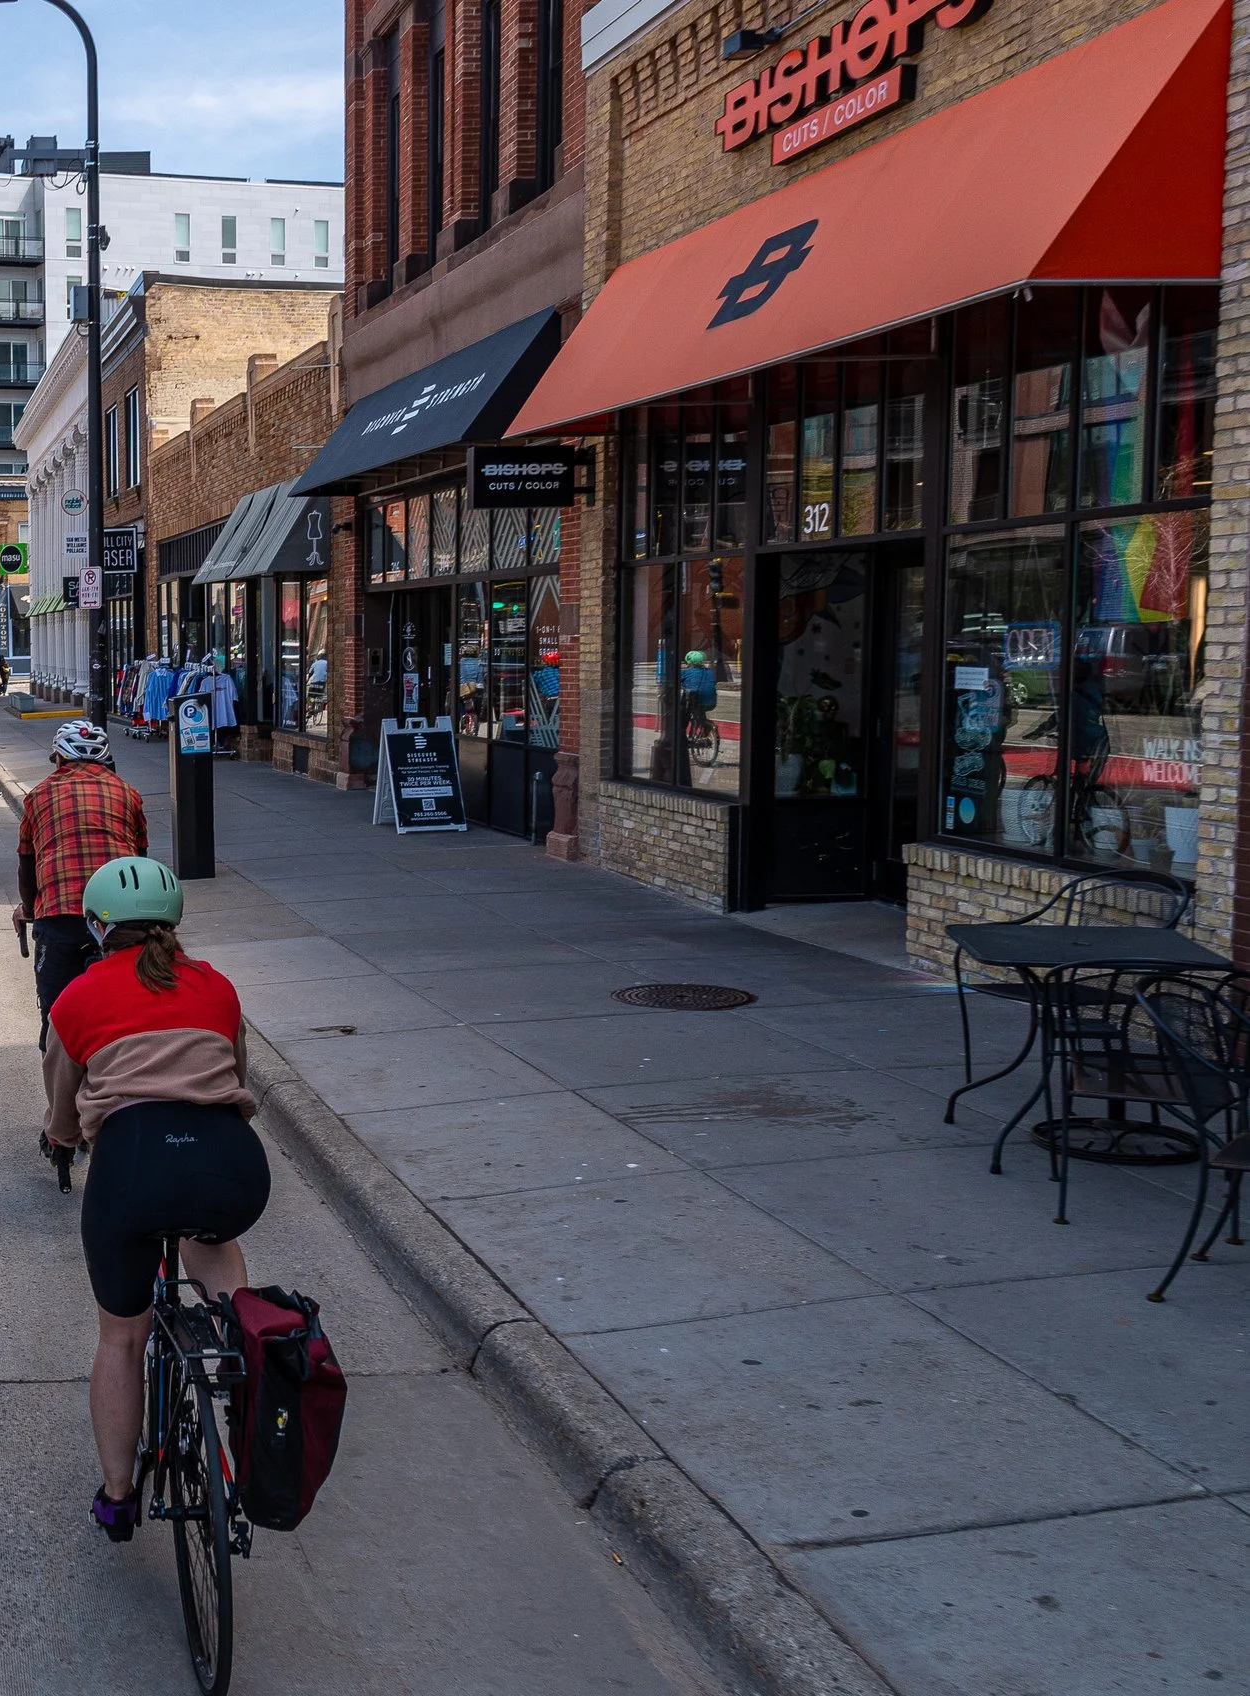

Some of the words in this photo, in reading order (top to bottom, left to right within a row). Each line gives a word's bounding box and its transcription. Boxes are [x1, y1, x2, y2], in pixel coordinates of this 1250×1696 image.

[782, 117, 819, 152] CUTS
[834, 80, 889, 127] COLOR
[361, 407, 407, 436] DISCOVER
[425, 372, 486, 410] STRENGTH
[481, 463, 567, 476] BISHOPS
[489, 482, 515, 491] CUTS
[525, 482, 560, 490] COLOR
[803, 502, 830, 534] 312
[104, 537, 115, 548] ILL
[116, 535, 133, 547] CITY
[1, 554, 21, 562] masu
[104, 549, 133, 566] ASER
[539, 636, 558, 645] SMALL
